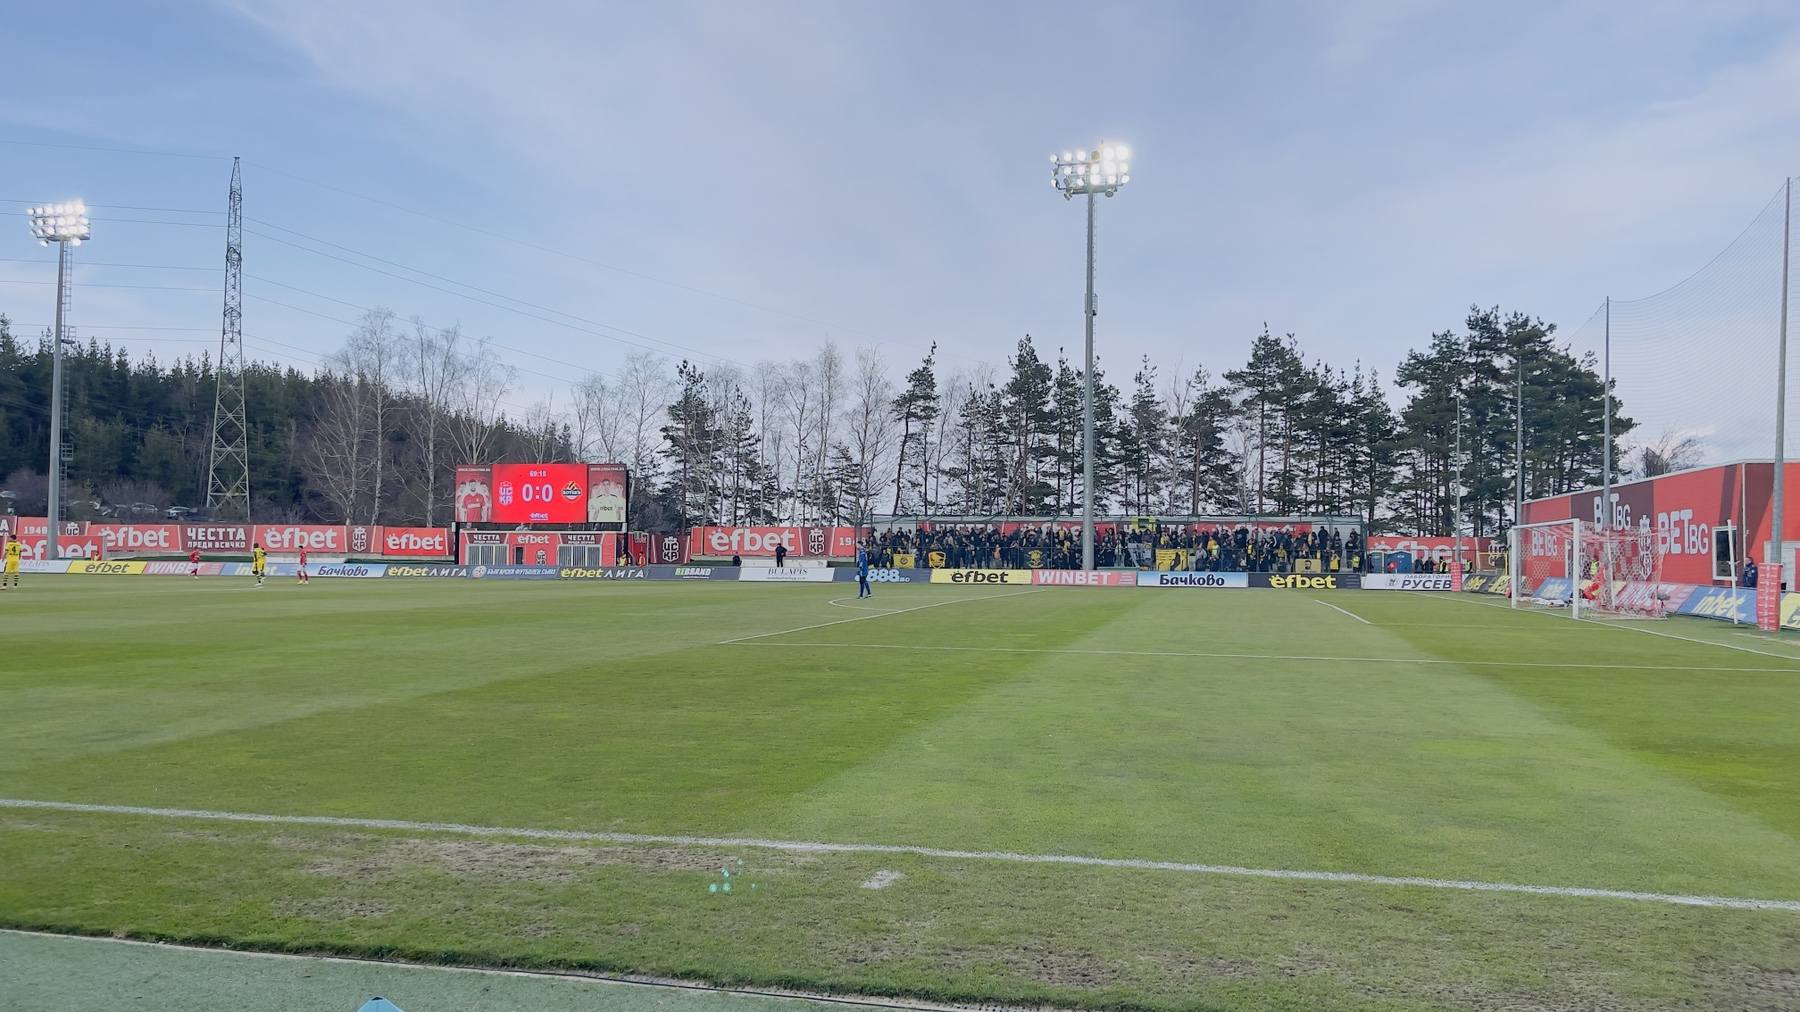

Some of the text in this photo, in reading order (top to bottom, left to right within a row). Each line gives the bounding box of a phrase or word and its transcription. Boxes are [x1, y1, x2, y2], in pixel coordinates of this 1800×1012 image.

[187, 527, 246, 541] ЧЕСТТА
[264, 527, 337, 549] efbet
[517, 534, 550, 544] efbet
[709, 528, 795, 551] efbet
[386, 533, 443, 550] efbet
[85, 561, 130, 574] efbet
[318, 565, 368, 577] Бачково
[951, 570, 1009, 583] efbet
[1039, 572, 1111, 585] WINBET
[1159, 573, 1225, 587] Бачково
[1268, 574, 1336, 589] efbet
